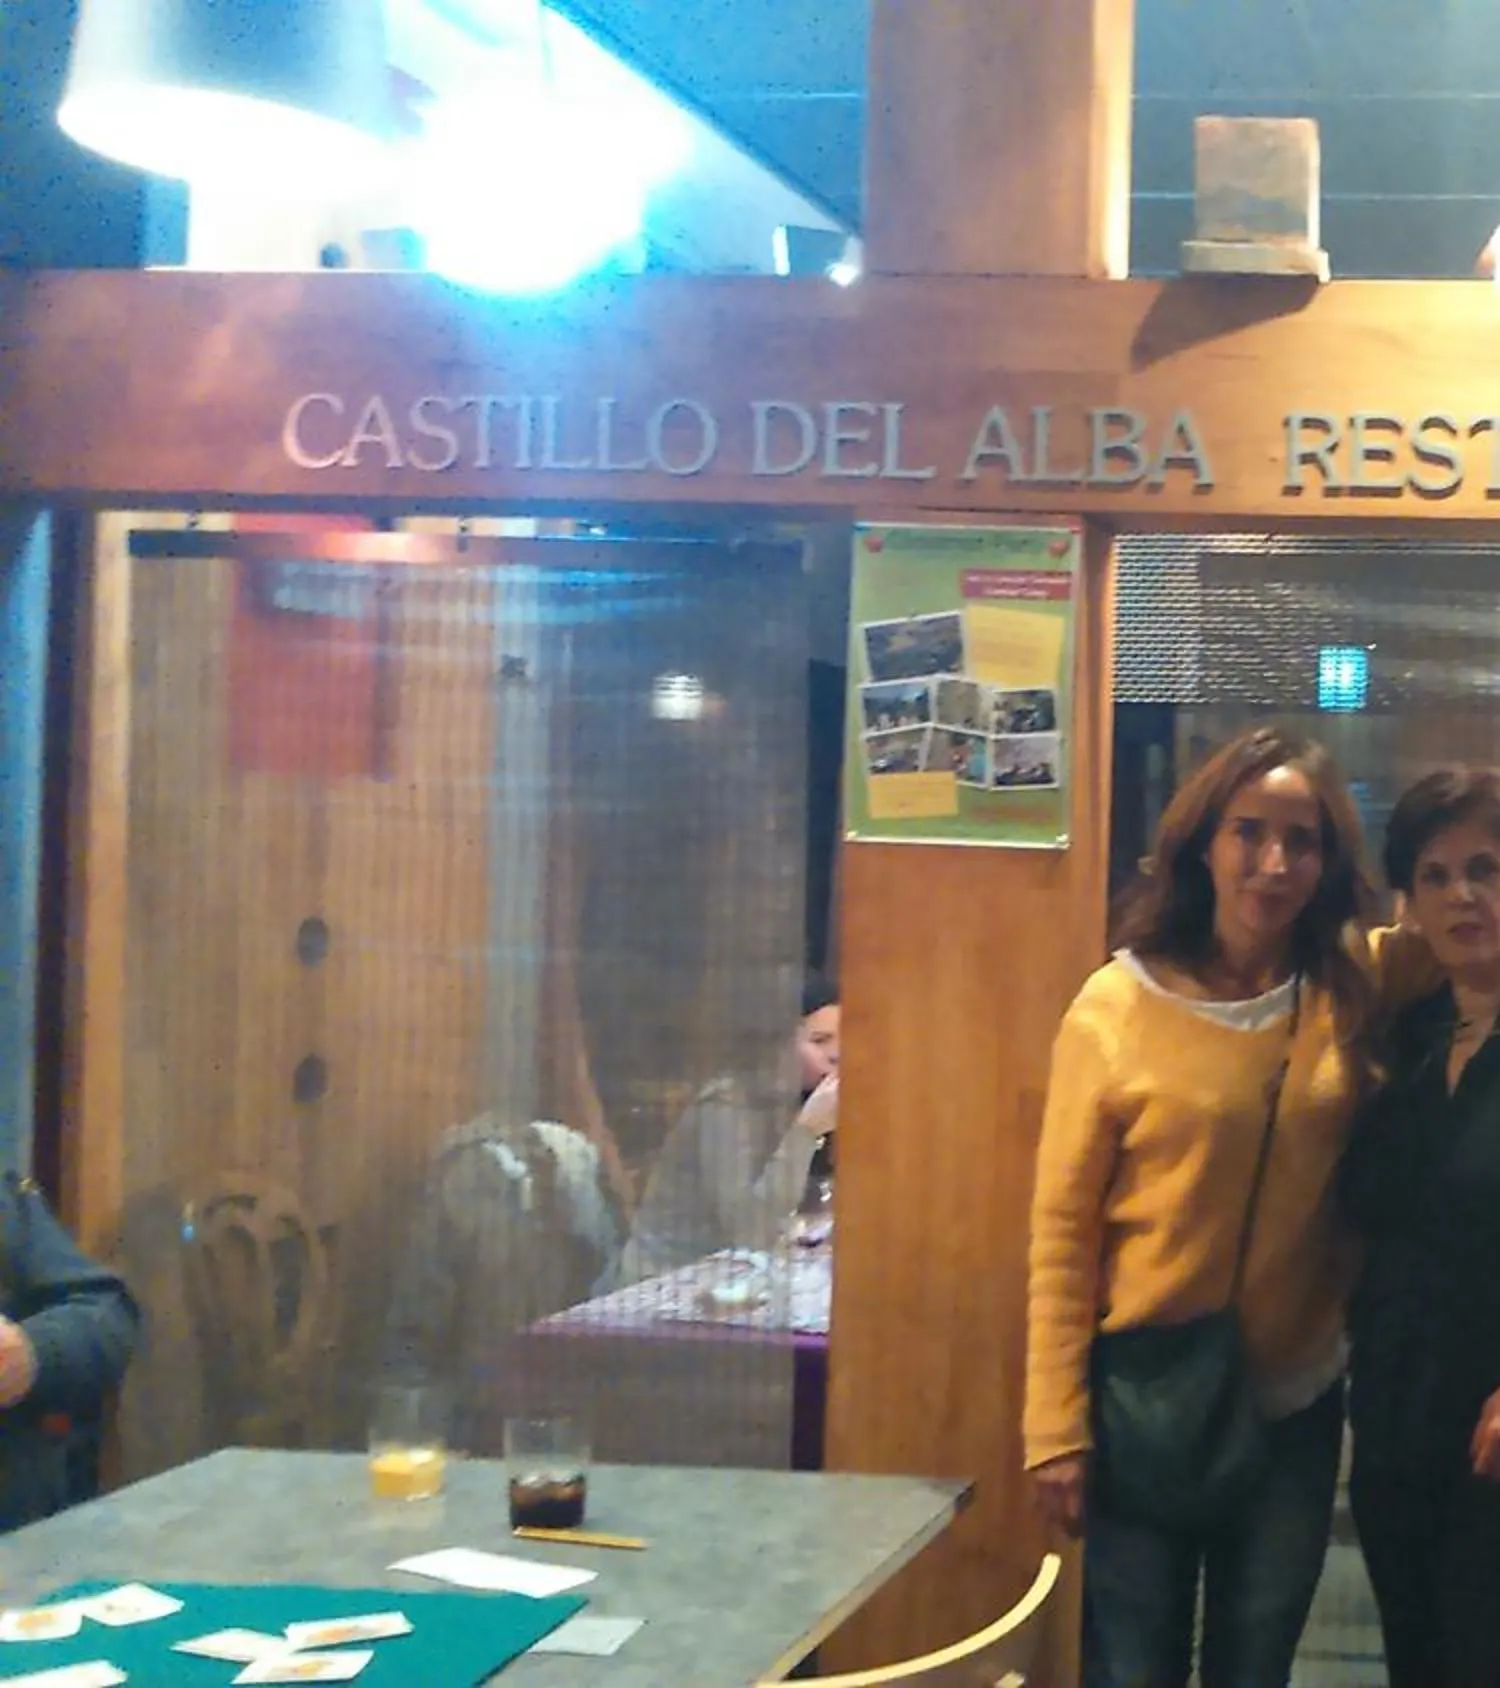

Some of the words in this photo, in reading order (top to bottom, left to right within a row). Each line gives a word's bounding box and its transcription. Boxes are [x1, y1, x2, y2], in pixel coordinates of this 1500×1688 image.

[281, 392, 720, 475] CASTILLO
[751, 400, 937, 480] DEL
[957, 403, 1216, 489] ALBA
